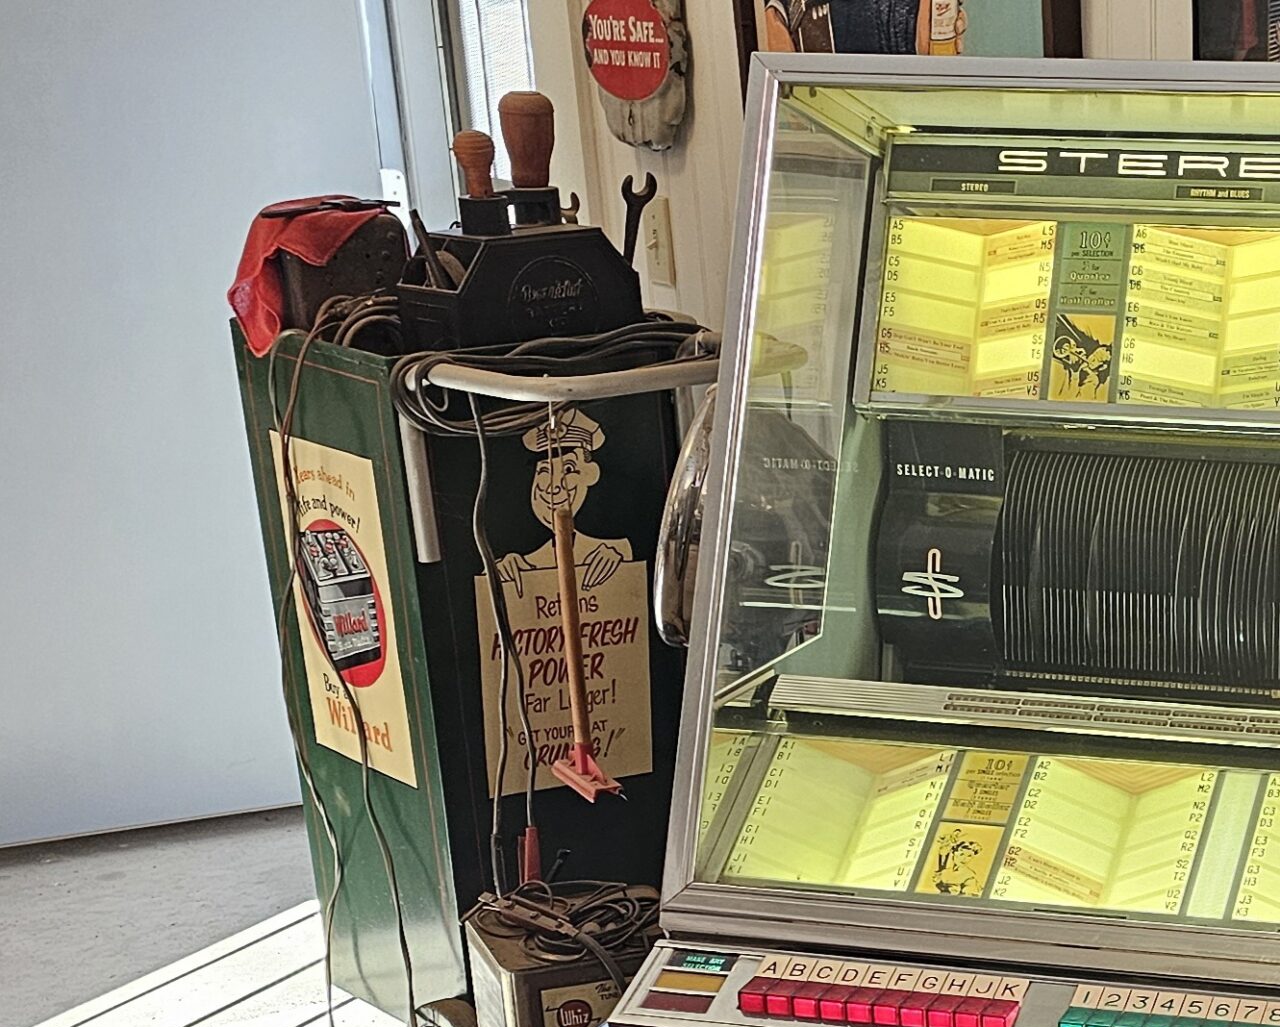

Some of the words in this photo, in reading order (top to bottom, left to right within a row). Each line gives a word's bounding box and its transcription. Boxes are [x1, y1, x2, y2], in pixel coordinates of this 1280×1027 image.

[593, 48, 609, 65] AND
[610, 49, 625, 66] YOU
[627, 50, 651, 68] KNOW
[653, 52, 660, 69] IT
[961, 182, 989, 193] STEREO
[1190, 188, 1216, 198] RHYTHM
[1217, 189, 1229, 198] and
[1229, 189, 1250, 199] BLUES
[1080, 231, 1111, 249] 10¢
[317, 465, 343, 489] ahead
[345, 481, 355, 501] in
[312, 494, 328, 511] and
[329, 501, 360, 533] power!
[535, 592, 599, 619] Retns
[333, 610, 369, 638] Willard
[491, 625, 566, 660] FCTORY
[580, 616, 639, 649] FRESH
[323, 673, 340, 699] Buy
[525, 692, 551, 714] Far
[559, 678, 616, 714] Lger!
[326, 696, 393, 752] Wilard
[592, 719, 608, 733] AT
[763, 961, 777, 974] A
[789, 964, 806, 977] B
[816, 966, 833, 979] C
[842, 968, 858, 982] D
[869, 971, 886, 985] E
[894, 973, 912, 986] F
[922, 976, 939, 990] G
[948, 978, 966, 992] H
[975, 980, 993, 994] J
[1001, 983, 1020, 997] K
[560, 1008, 589, 1027] Whiz
[1085, 991, 1090, 1004] 1
[1104, 993, 1121, 1007] 2
[1132, 995, 1149, 1009] 3
[1160, 998, 1175, 1012] 4
[1187, 1000, 1204, 1014] 5
[1214, 1003, 1231, 1017] 6
[1243, 1005, 1259, 1019] 7
